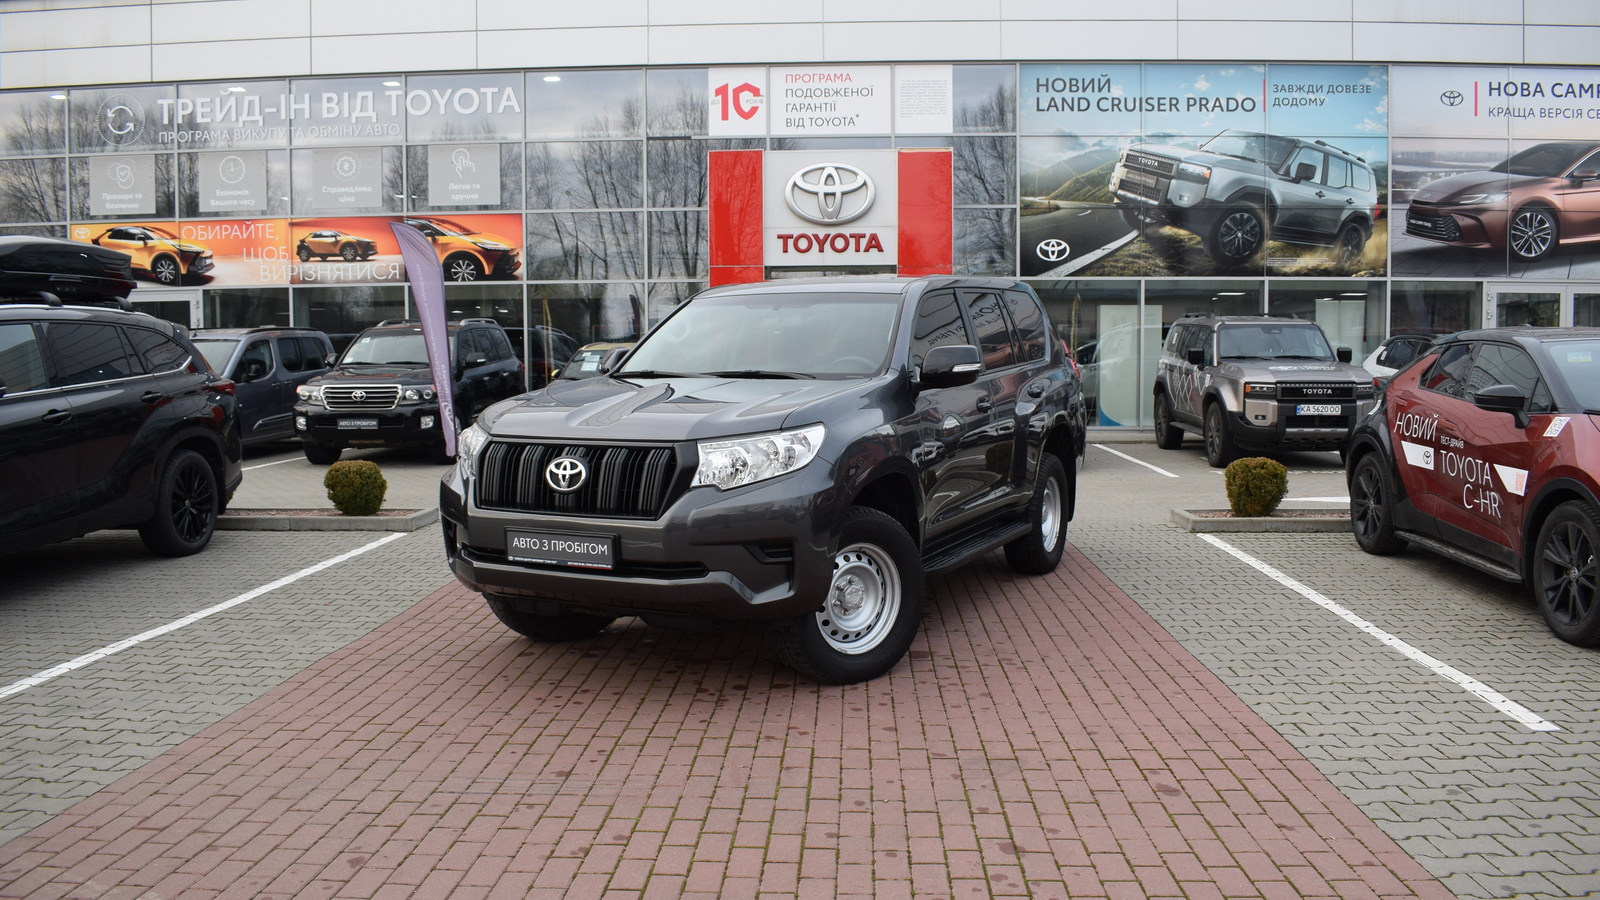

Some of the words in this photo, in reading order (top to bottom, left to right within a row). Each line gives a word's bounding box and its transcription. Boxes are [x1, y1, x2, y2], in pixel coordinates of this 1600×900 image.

[785, 73, 852, 84] ПРОГРАМА
[1036, 73, 1111, 93] НОВИЙ
[785, 84, 875, 100] ПОДОВЖЕНОЇ
[1273, 84, 1323, 95] ЗАВЖДИ
[1327, 84, 1372, 95] ДОВЕЗЕ
[1488, 81, 1545, 97] НОВА
[1551, 82, 1600, 98] CAM
[157, 89, 311, 127] ТРЕЙД-ІН
[322, 90, 378, 123] ВІД
[384, 86, 521, 117] TOYOTA
[785, 99, 837, 113] ГАРАНТІЇ
[1036, 96, 1091, 112] LAND
[1096, 96, 1180, 112] CRUISER
[1186, 96, 1256, 113] PRADO
[1272, 97, 1326, 108] ДОДОМУ
[1488, 106, 1536, 119] КРАЩА
[1540, 107, 1583, 119] ВЕРСІЯ
[785, 117, 806, 129] ВІД
[158, 129, 231, 144] ПРОГРАМА
[234, 126, 287, 141] ВИКУПУ
[308, 124, 361, 138] ОБМІНУ
[366, 123, 400, 137] АВТО
[1138, 156, 1159, 167] TOYOTA
[181, 221, 280, 241] ОБИРАЙТЕ,
[776, 232, 884, 254] TOYOTA
[243, 246, 289, 264] ЩОБ
[260, 262, 400, 282] ВИРІЗНЯТИСЯ
[1300, 405, 1311, 413] KA
[1312, 405, 1329, 413] 5620
[1393, 412, 1439, 442] НОВИЙ
[1440, 450, 1493, 488] TOYOTA
[1463, 484, 1501, 519] C-HR
[512, 537, 540, 551] АВТО
[541, 538, 549, 551] З
[551, 539, 608, 556] ПРОБІГОМ
